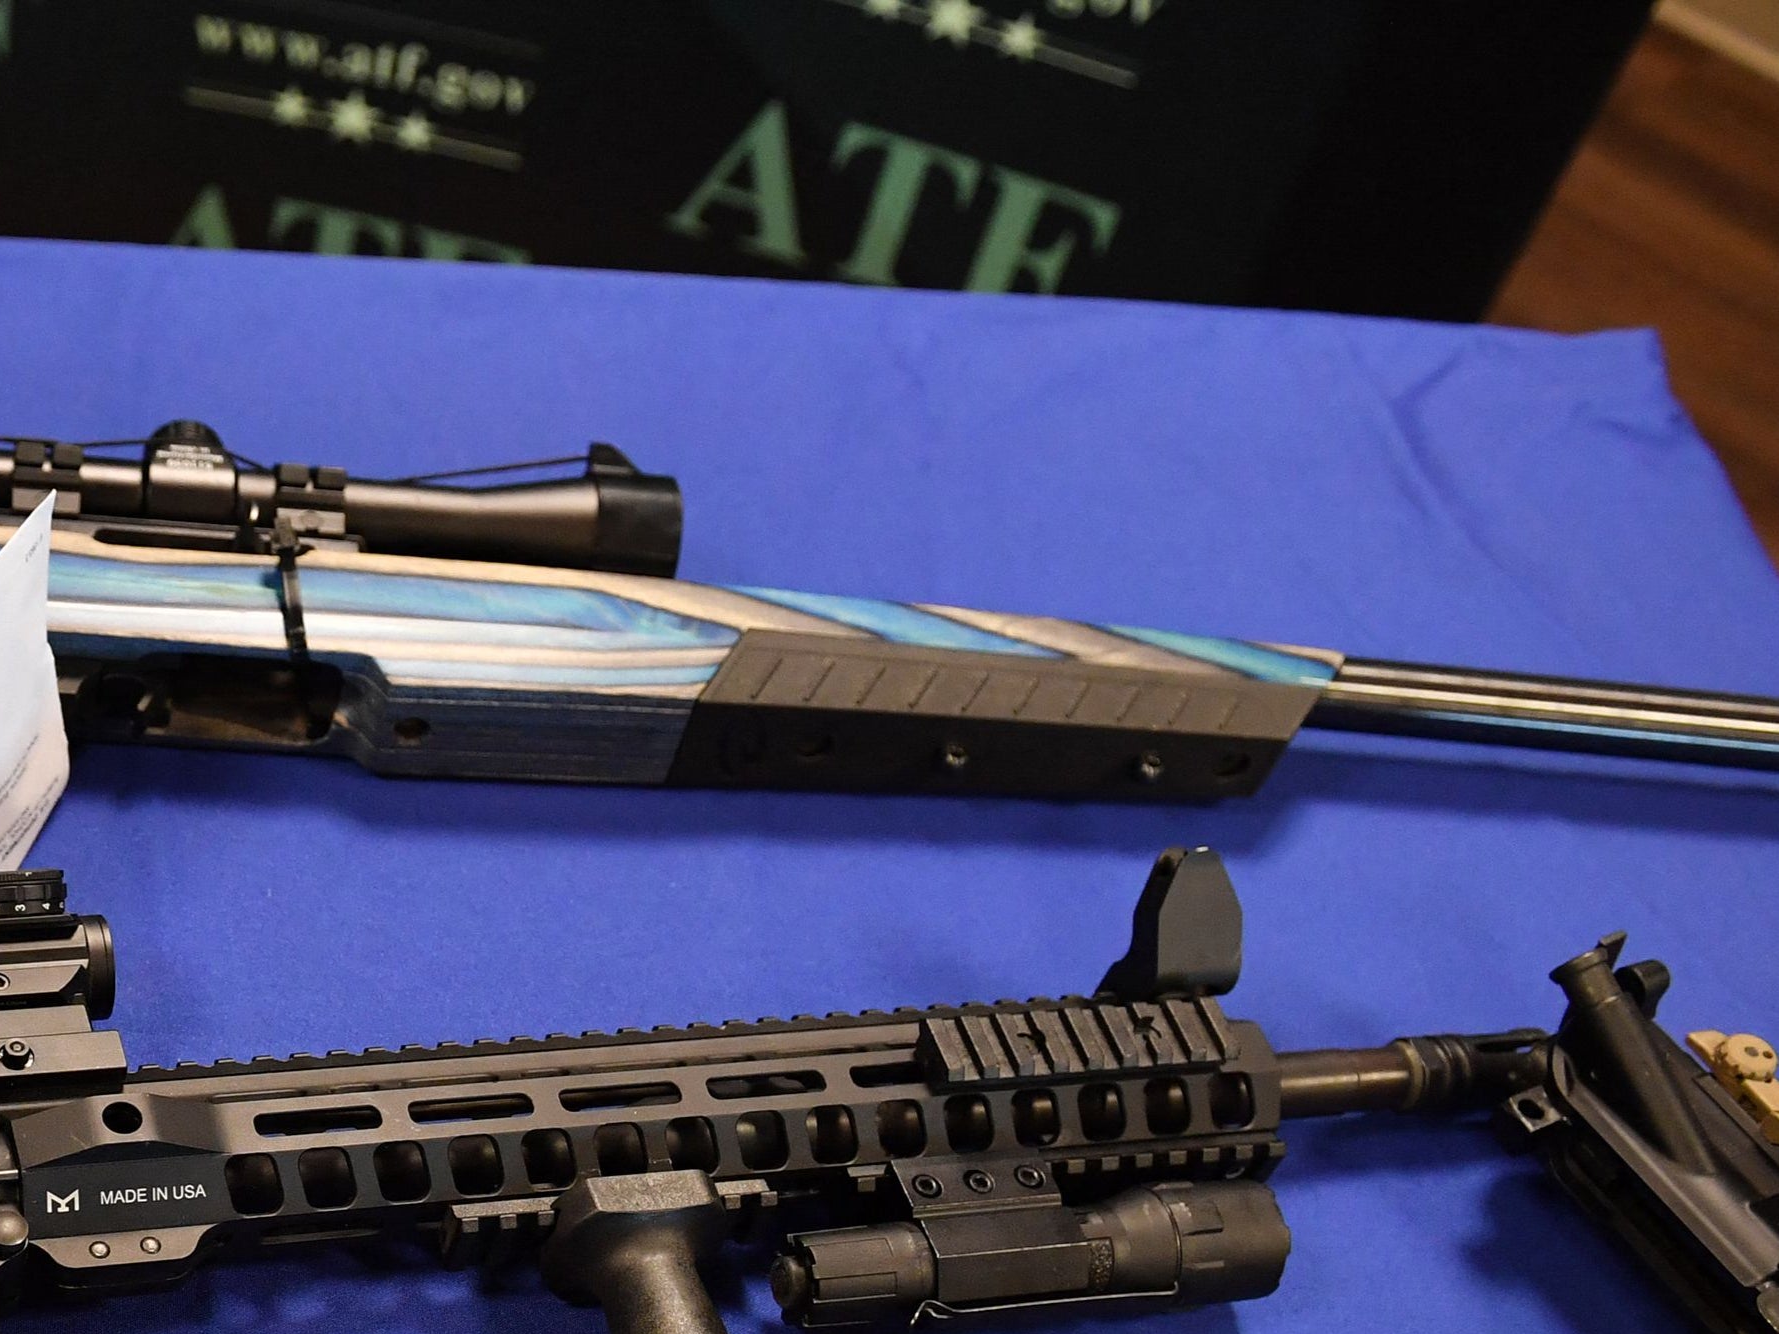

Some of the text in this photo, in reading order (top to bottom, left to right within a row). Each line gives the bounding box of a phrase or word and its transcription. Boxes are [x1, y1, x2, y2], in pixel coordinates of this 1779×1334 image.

[196, 15, 534, 114] www.atf.gov
[668, 100, 1118, 296] ATF
[42, 902, 51, 910] 4
[100, 1184, 207, 1205] MADE IN USA
